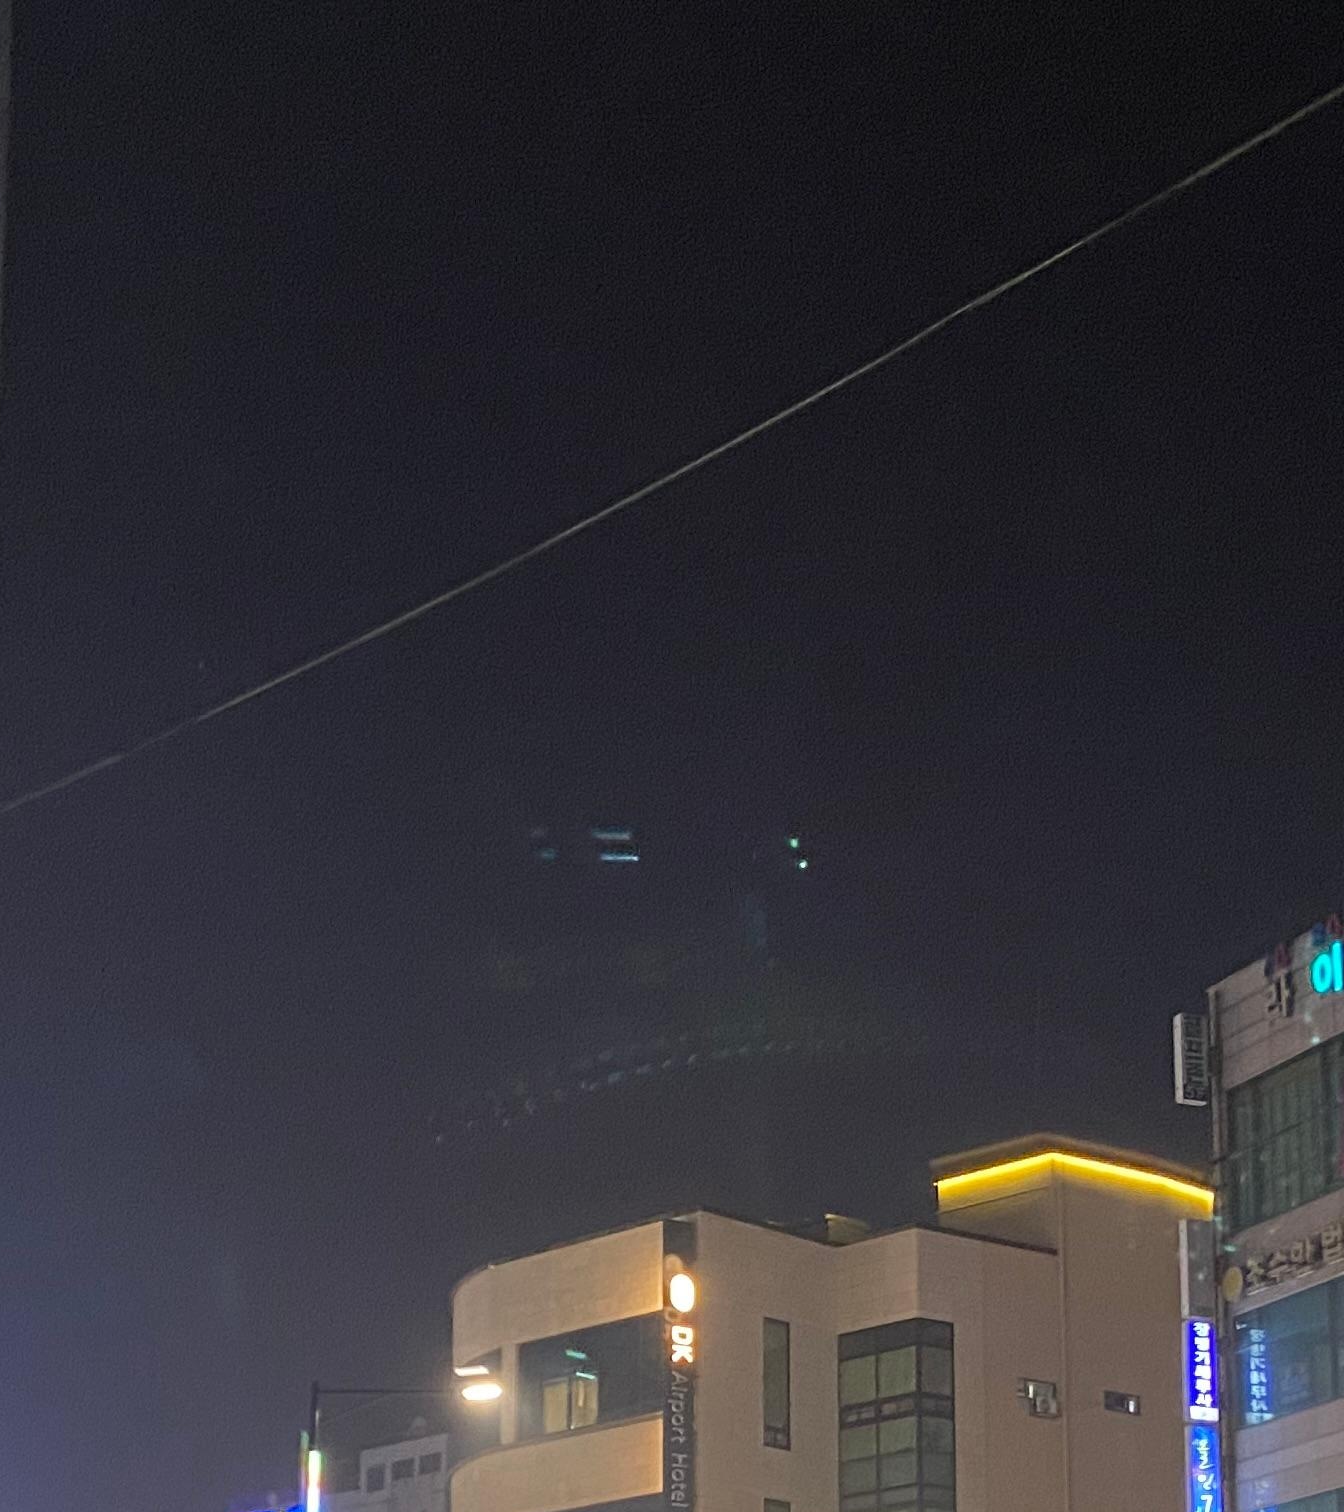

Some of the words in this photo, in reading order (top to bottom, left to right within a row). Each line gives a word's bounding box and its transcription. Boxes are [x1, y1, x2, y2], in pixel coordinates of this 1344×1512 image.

[670, 1325, 694, 1364] DK
[666, 1371, 689, 1443] Airport
[669, 1452, 690, 1508] Hotel
